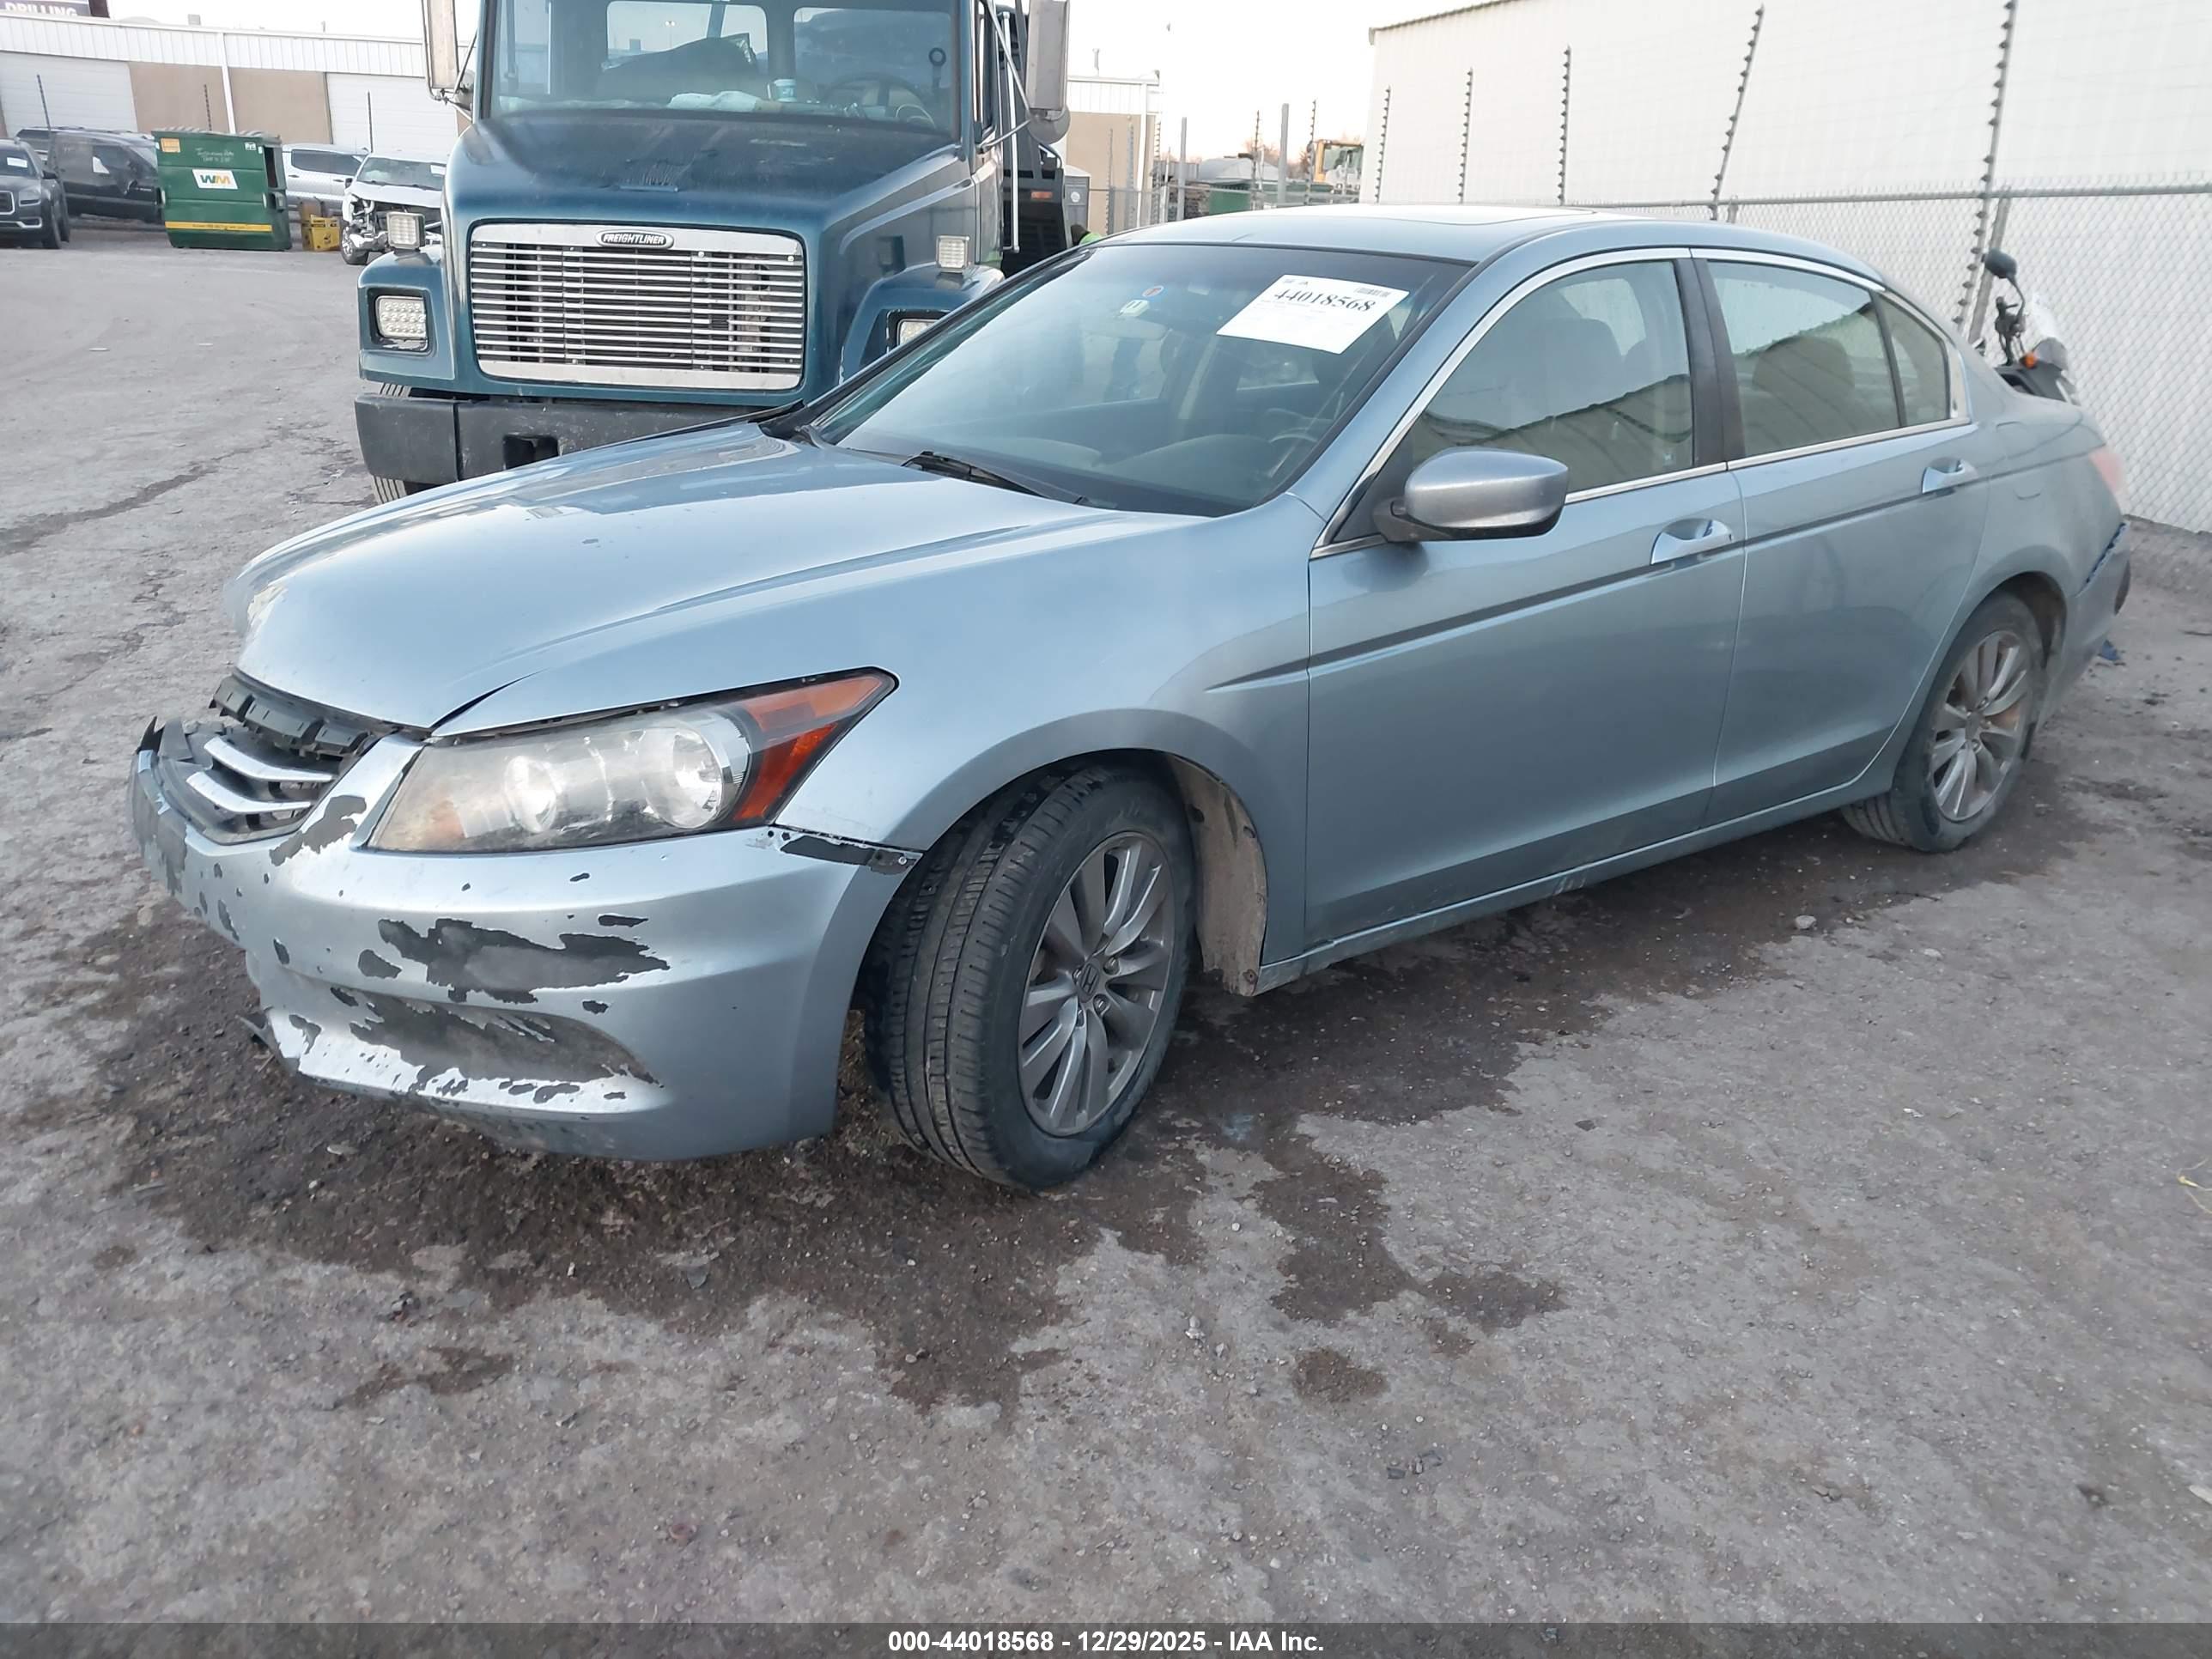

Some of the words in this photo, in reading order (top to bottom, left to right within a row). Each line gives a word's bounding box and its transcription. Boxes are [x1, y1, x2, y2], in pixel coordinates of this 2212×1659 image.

[200, 174, 231, 185] WM
[603, 233, 665, 245] FREIGHTLINER
[1274, 289, 1376, 312] 44018568
